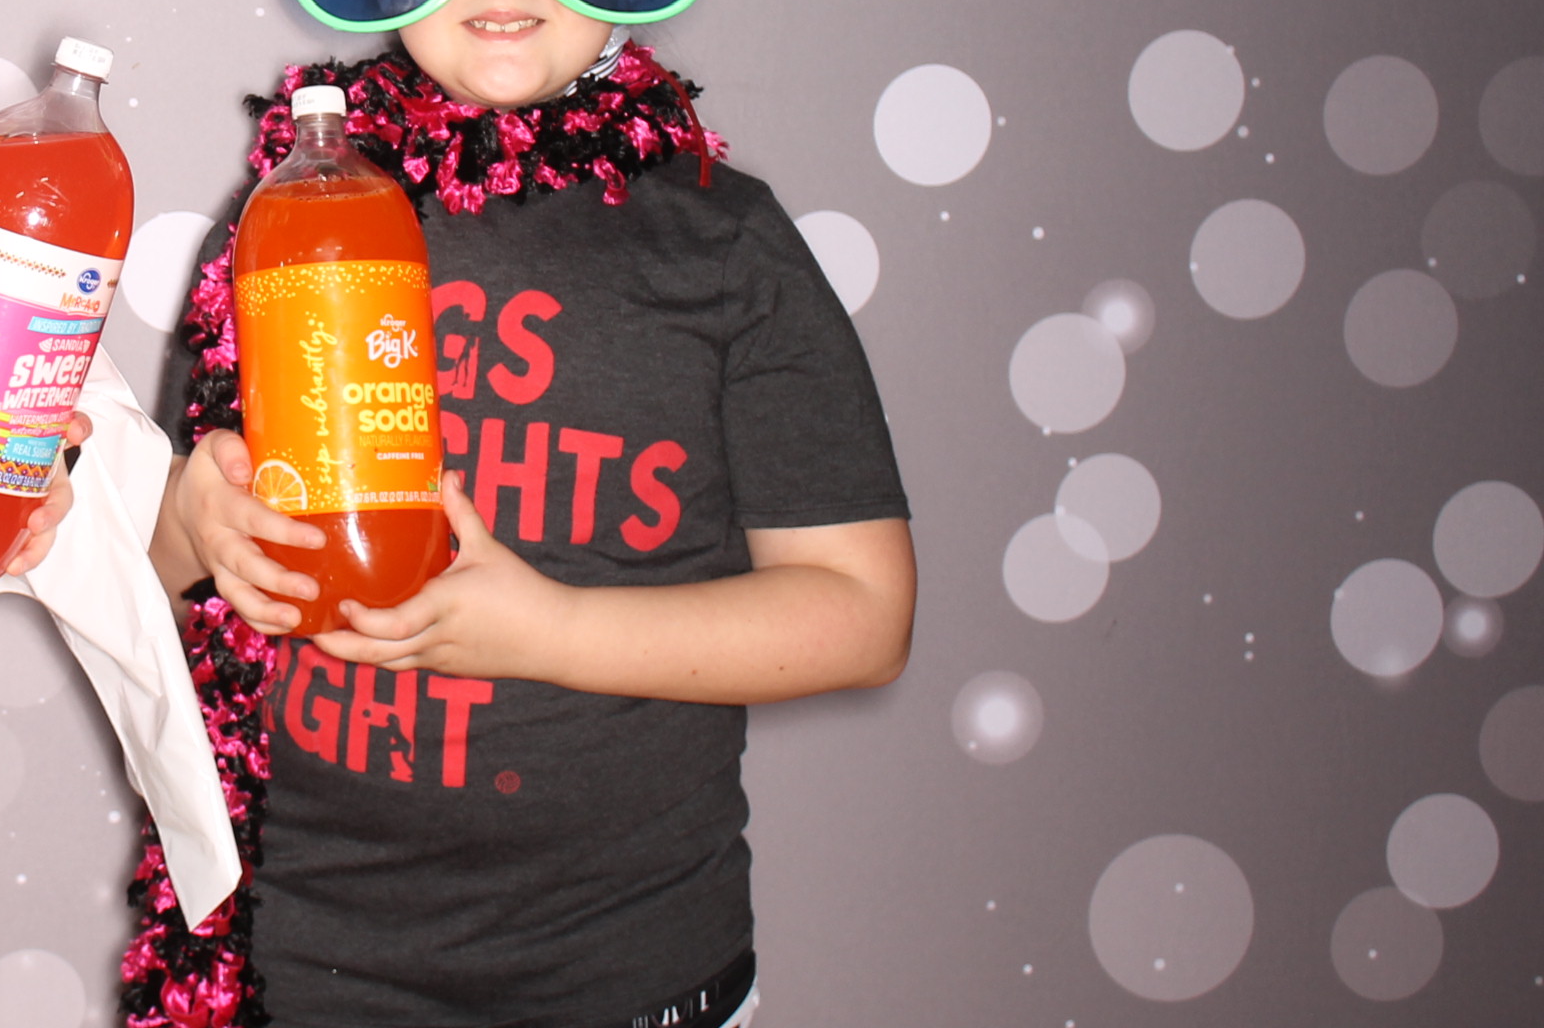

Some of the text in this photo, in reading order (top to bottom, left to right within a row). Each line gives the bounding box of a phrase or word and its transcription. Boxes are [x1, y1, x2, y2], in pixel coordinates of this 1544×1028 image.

[431, 280, 563, 405] GS
[342, 382, 434, 409] orange
[358, 406, 429, 432] soda
